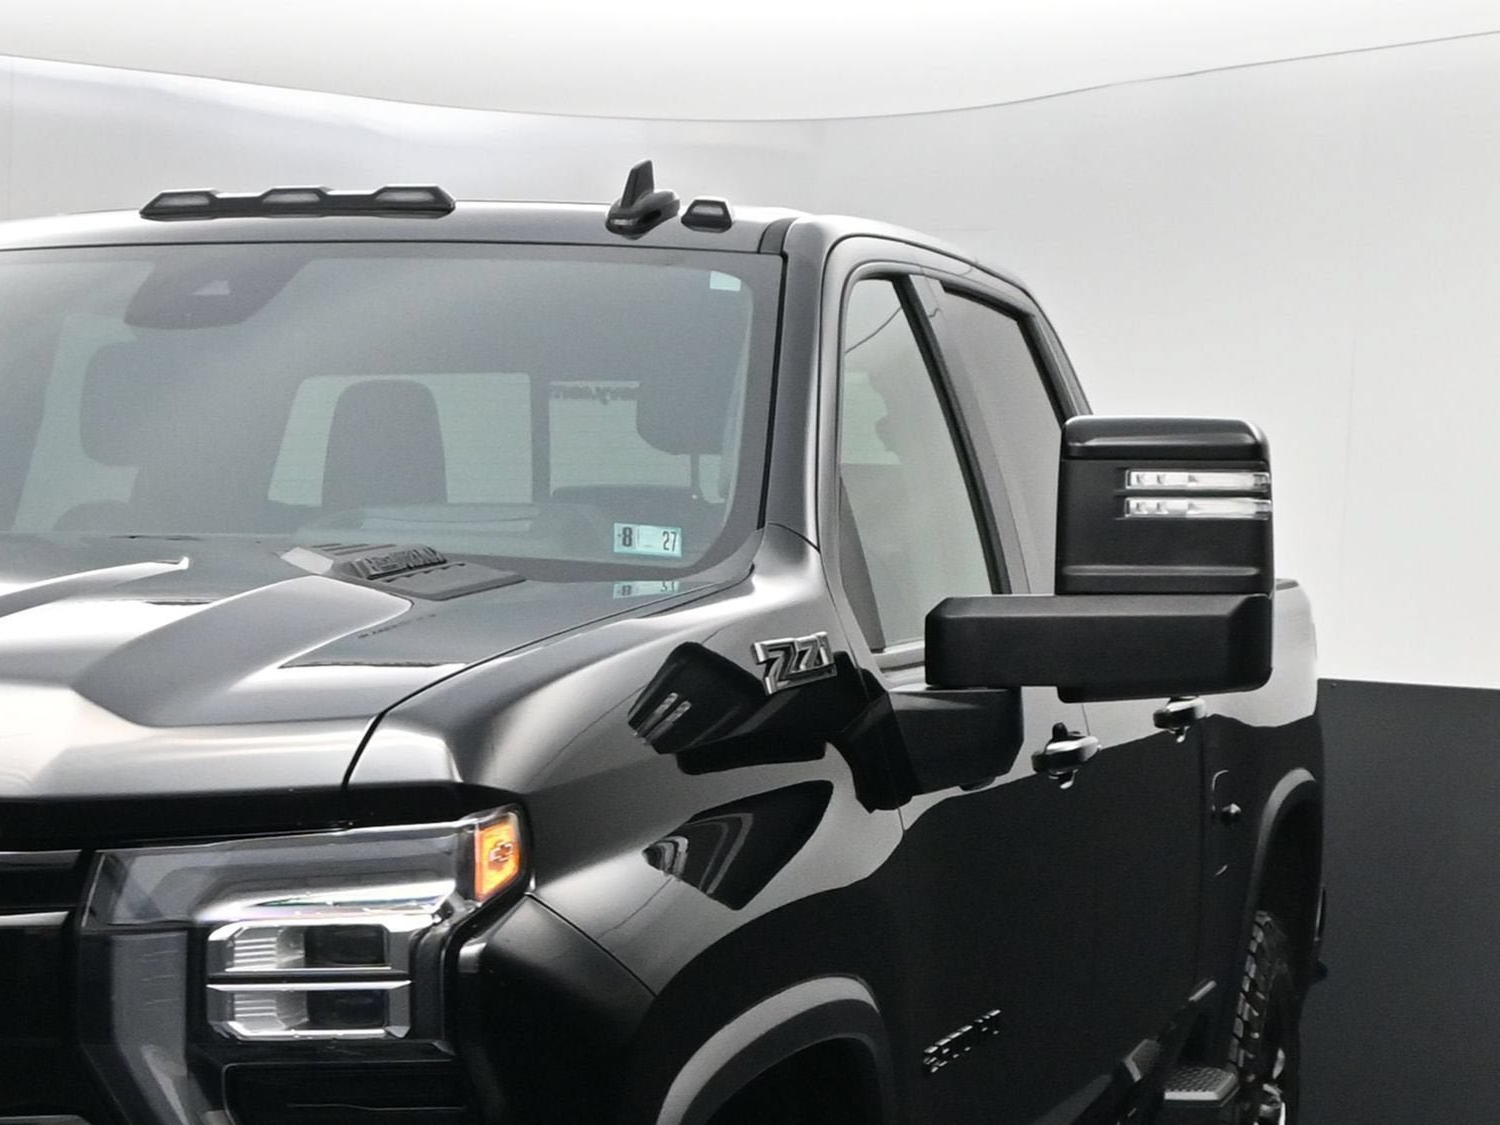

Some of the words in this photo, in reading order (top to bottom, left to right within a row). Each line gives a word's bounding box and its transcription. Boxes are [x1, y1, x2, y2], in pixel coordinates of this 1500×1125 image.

[622, 526, 633, 547] 8
[662, 530, 677, 552] 27
[751, 631, 838, 695] Z71
